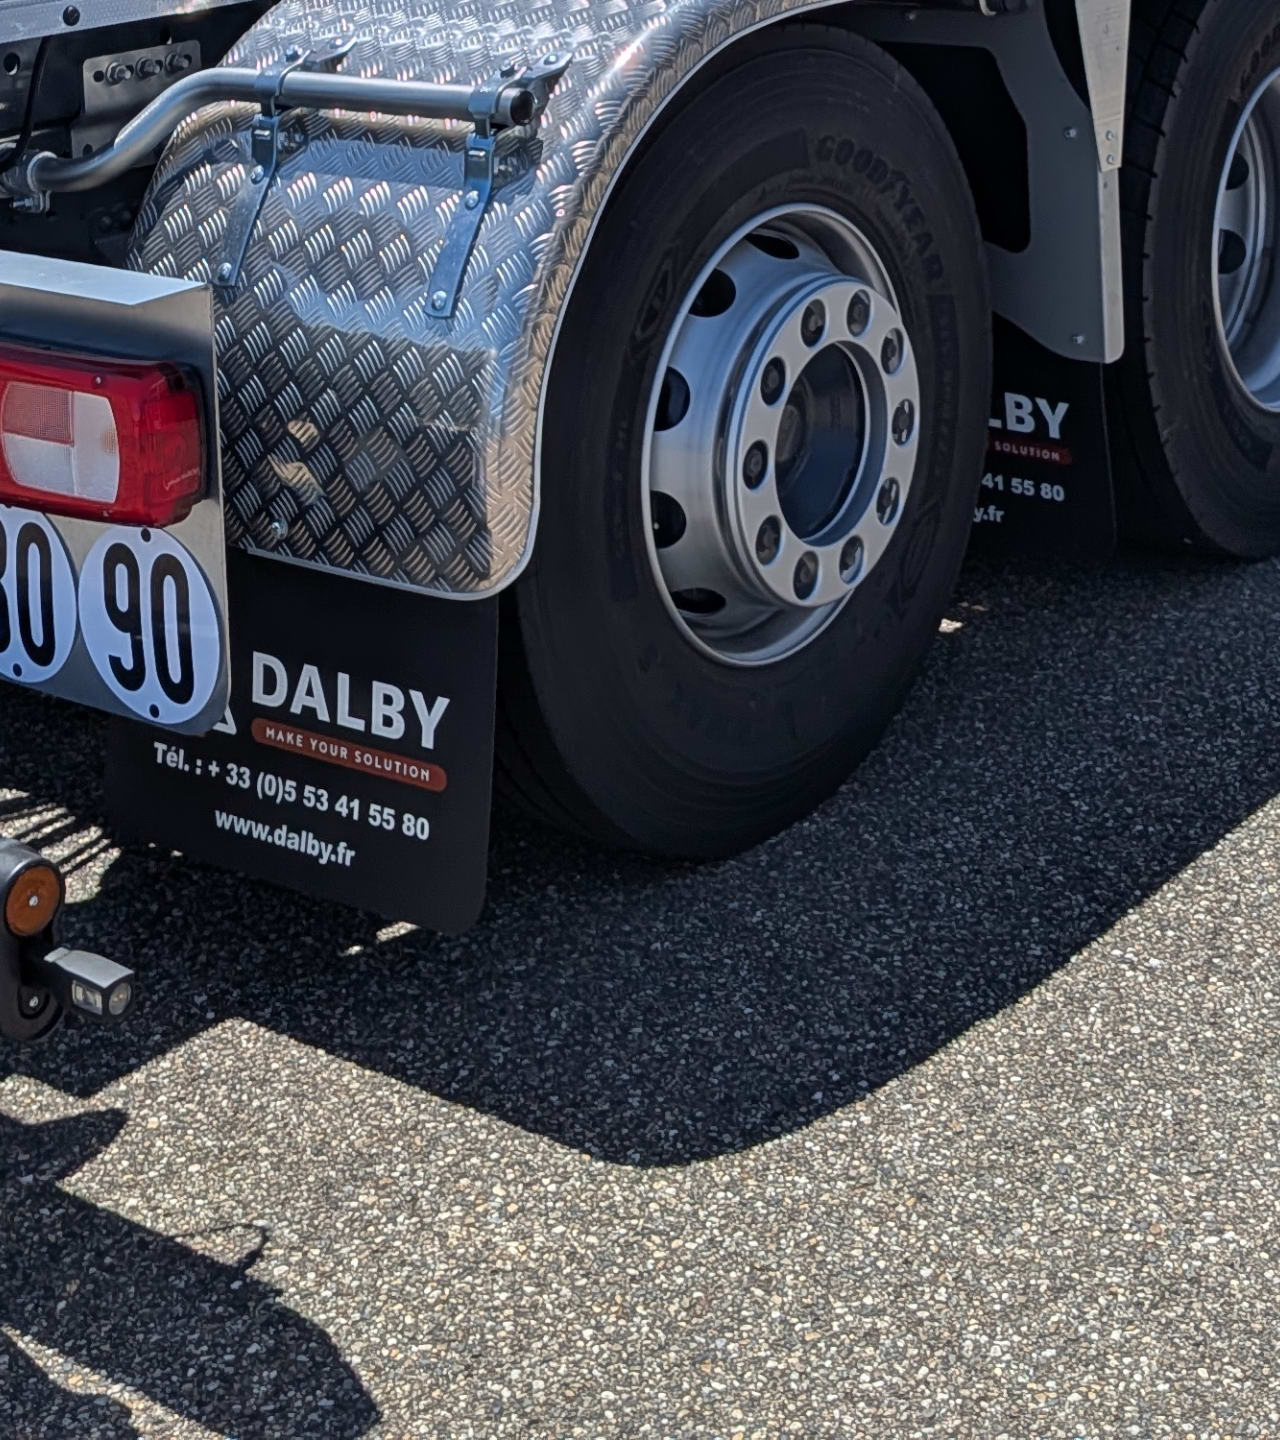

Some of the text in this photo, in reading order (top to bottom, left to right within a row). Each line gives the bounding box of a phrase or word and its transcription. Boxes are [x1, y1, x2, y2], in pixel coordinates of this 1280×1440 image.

[994, 441, 1061, 461] SOLUTION
[981, 472, 1065, 502] 41 55 80
[103, 542, 195, 704] 90
[252, 651, 450, 750] DALBY
[265, 727, 430, 782] MAKE YOUR SOLUTION
[226, 763, 251, 789] 33
[257, 772, 297, 805] (0)5
[303, 785, 329, 812] 53
[335, 795, 361, 821] 41
[368, 803, 396, 831] 55
[402, 815, 430, 840] 80
[214, 810, 356, 867] www.dalby.fr
